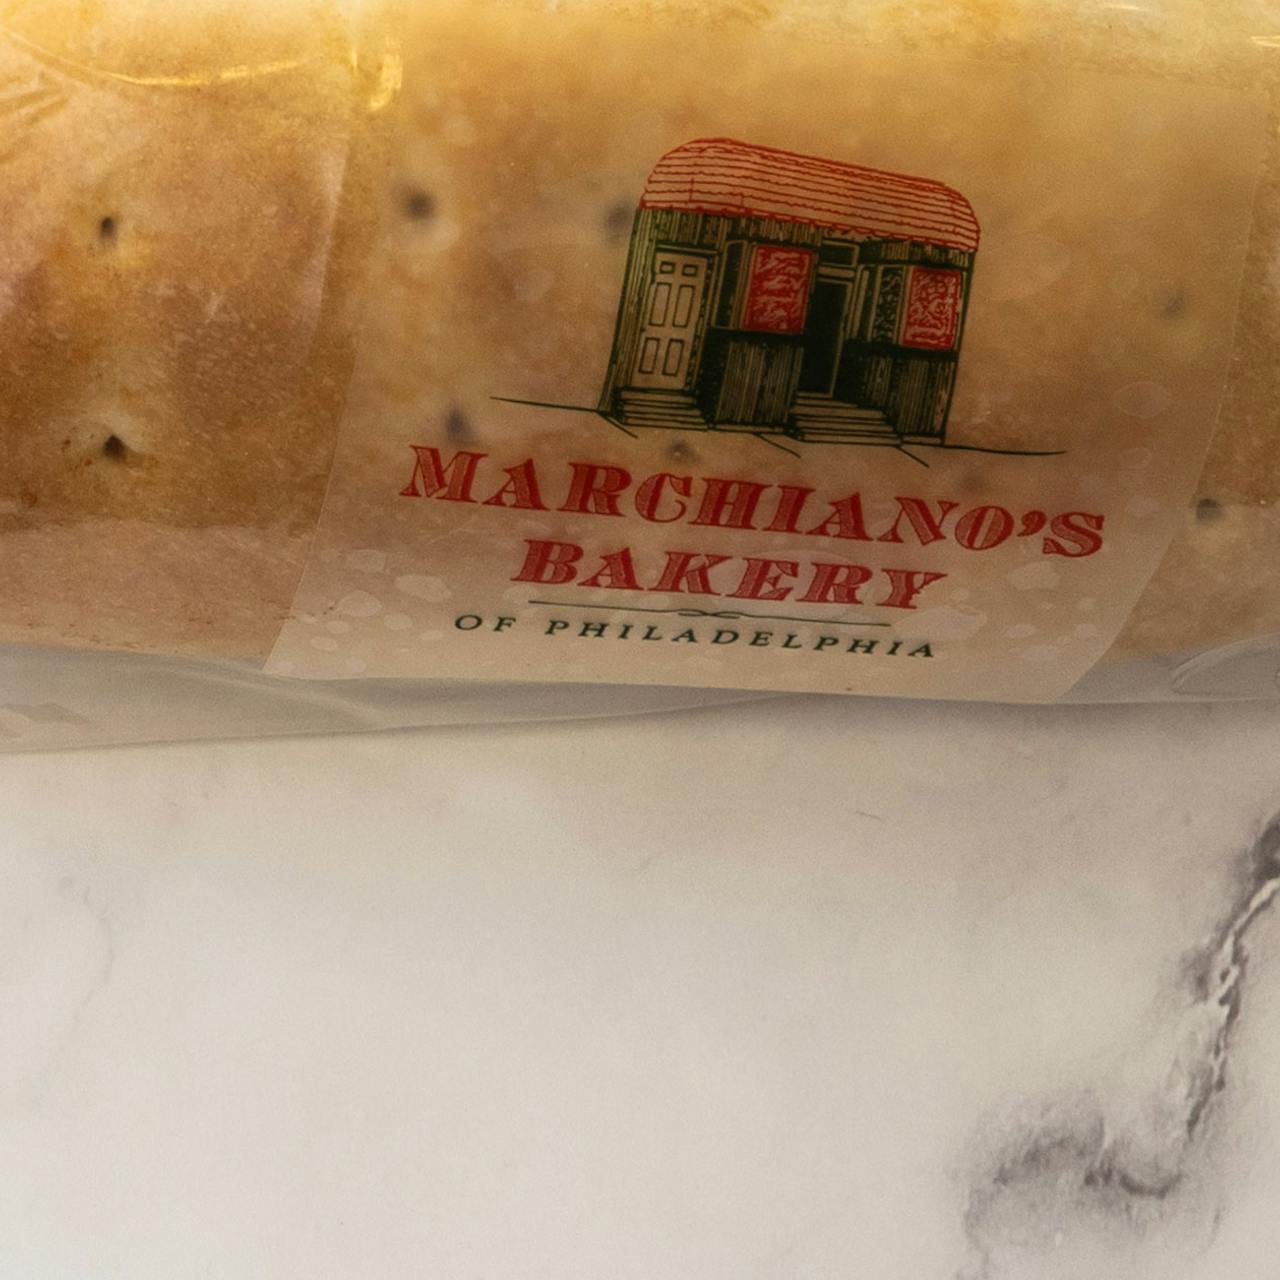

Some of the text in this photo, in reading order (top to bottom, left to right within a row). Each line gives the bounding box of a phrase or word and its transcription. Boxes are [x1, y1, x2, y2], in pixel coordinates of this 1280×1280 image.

[400, 445, 1106, 557] MARCHIANO'S
[511, 538, 948, 610] BAKERY
[454, 614, 935, 659] OF PHILADELPHIA
